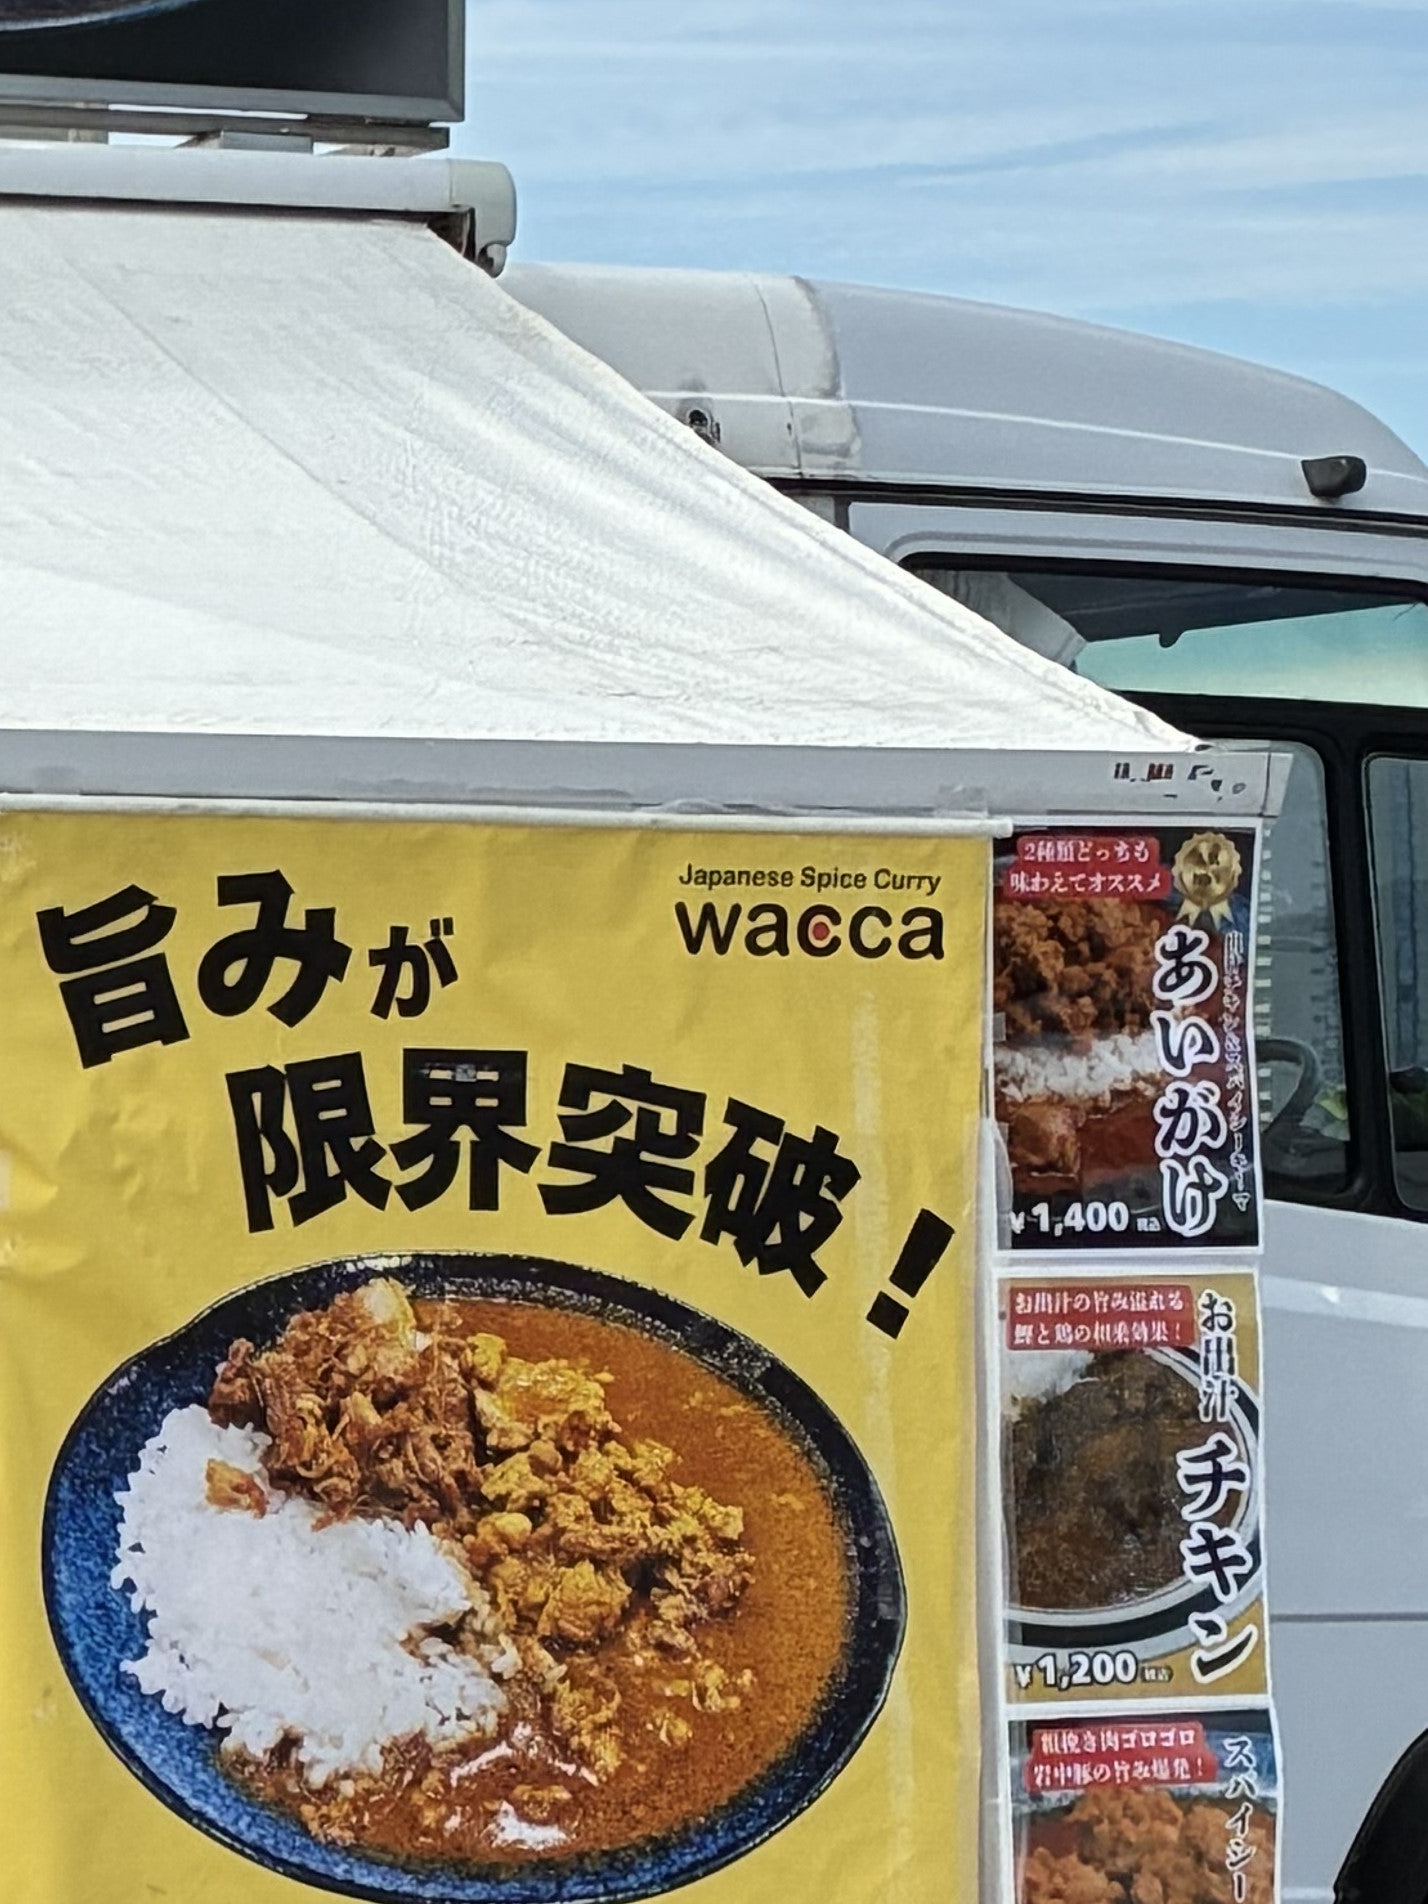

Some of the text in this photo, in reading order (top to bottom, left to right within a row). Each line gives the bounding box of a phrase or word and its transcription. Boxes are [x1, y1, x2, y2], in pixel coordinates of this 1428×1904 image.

[674, 898, 946, 962] wacca
[677, 862, 942, 897] Japanese Spice Curry
[35, 869, 459, 1070] 旨みが
[1149, 924, 1230, 1238] あいがけ
